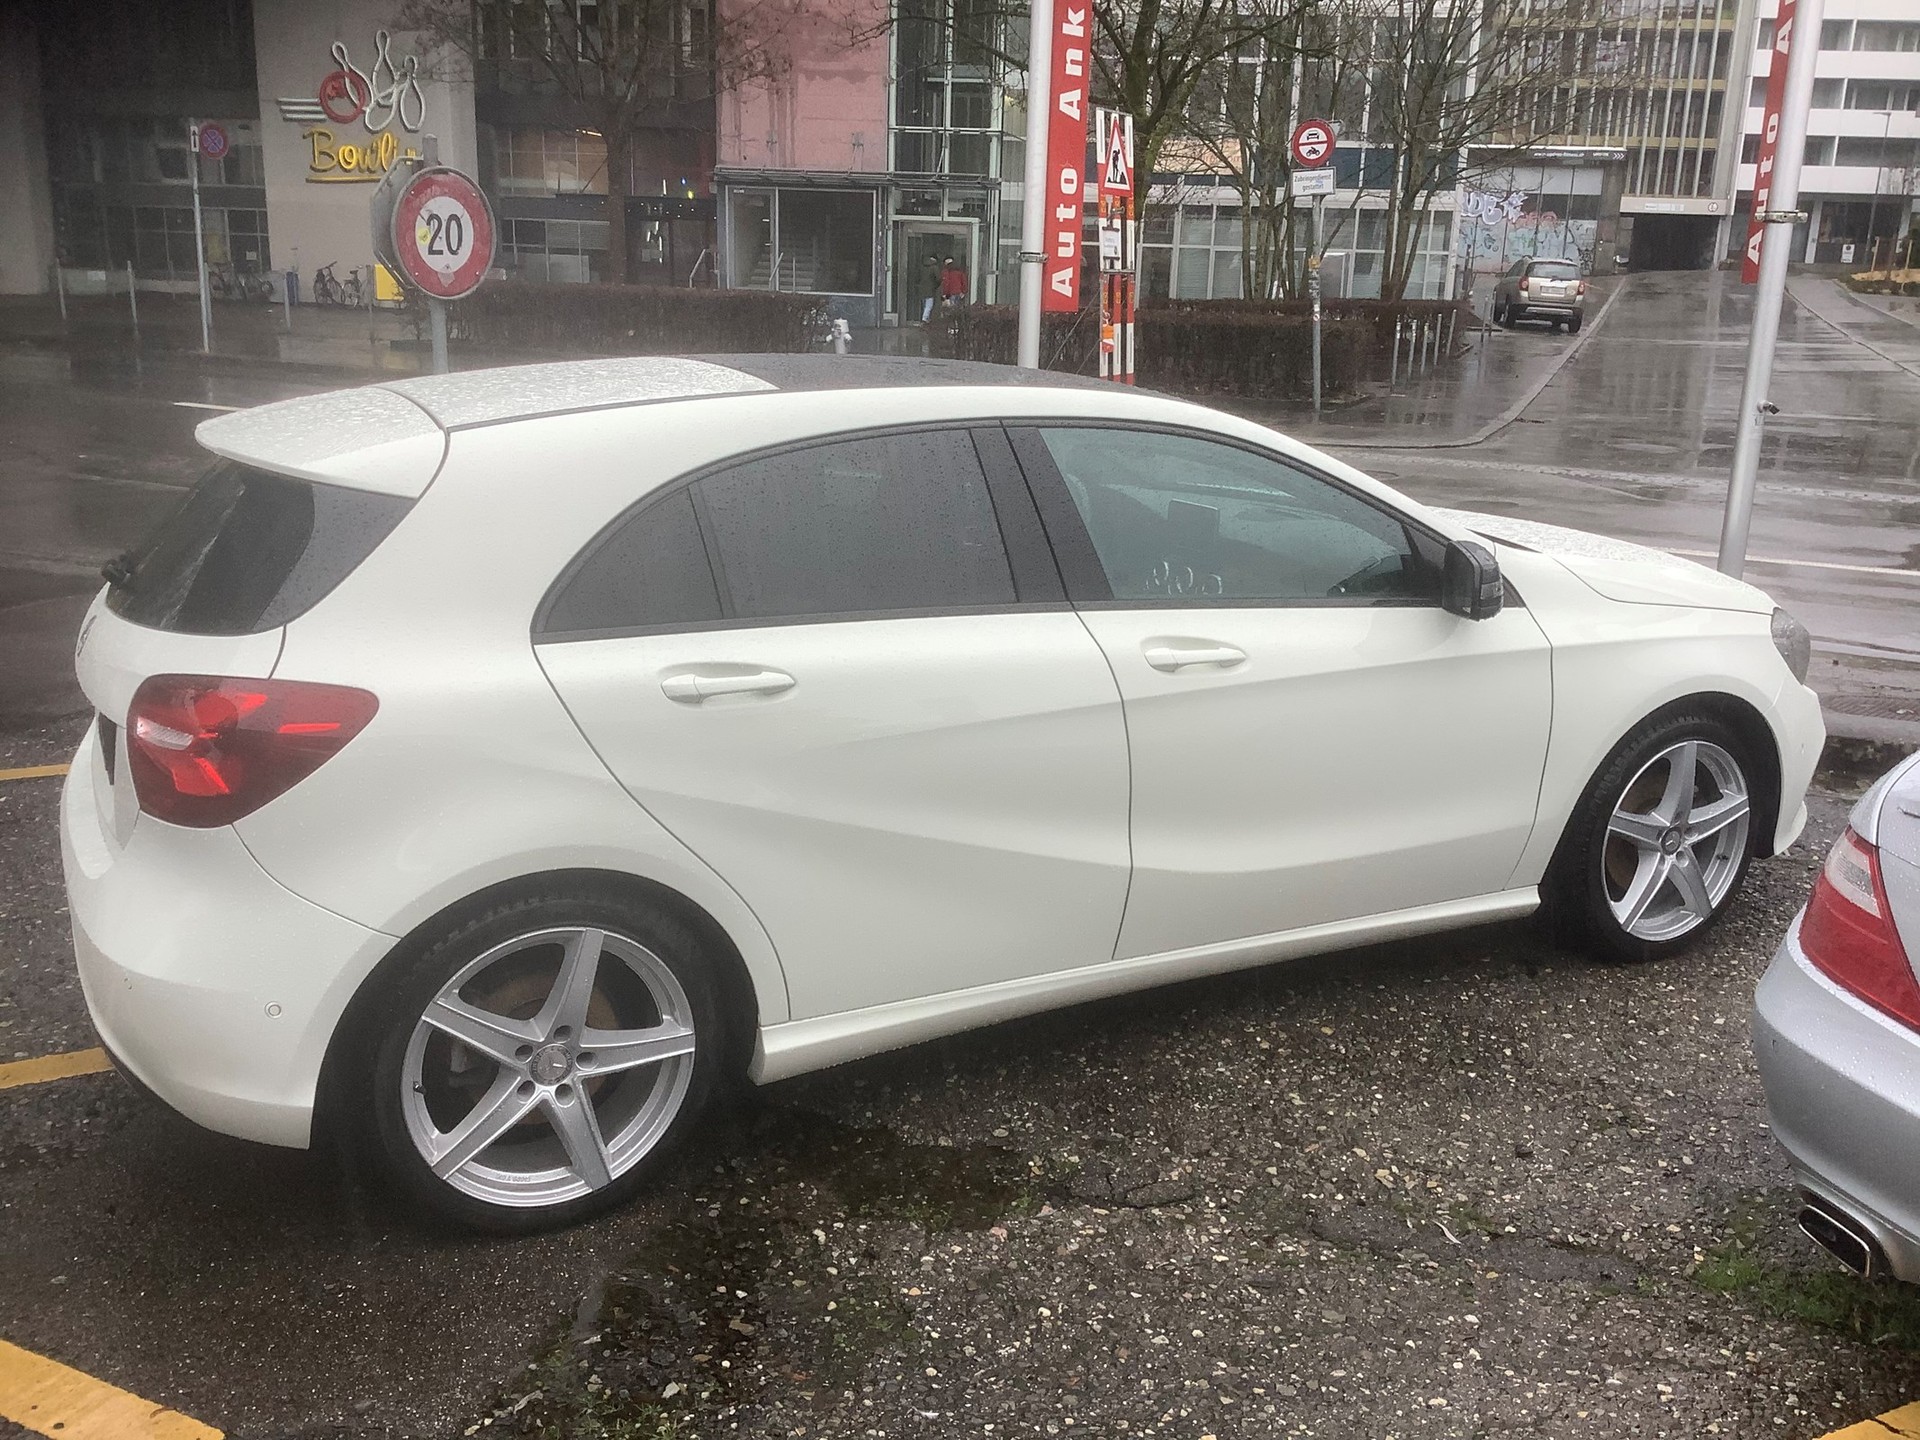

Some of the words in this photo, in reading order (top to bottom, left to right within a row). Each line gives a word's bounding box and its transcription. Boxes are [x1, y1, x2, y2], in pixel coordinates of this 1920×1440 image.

[1059, 6, 1085, 121] Ank
[426, 213, 463, 256] 20
[1051, 167, 1079, 298] Auto
[1747, 113, 1779, 265] Auto
